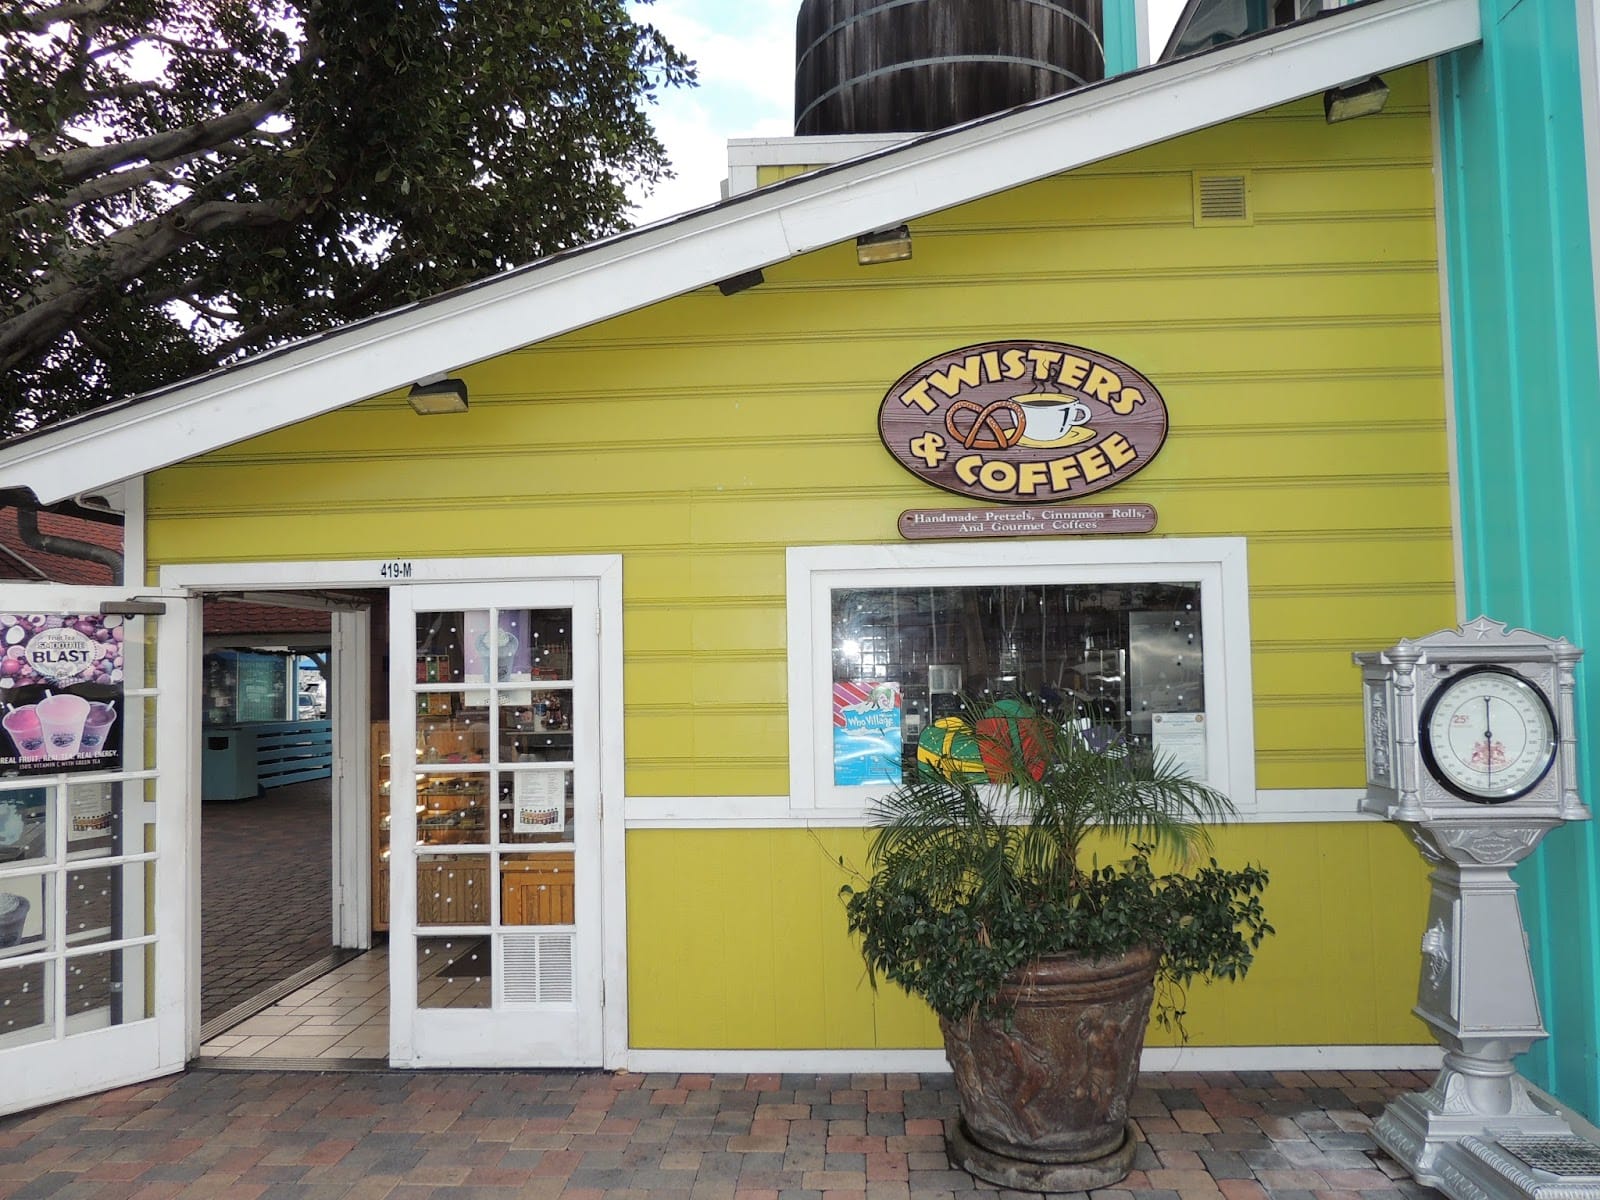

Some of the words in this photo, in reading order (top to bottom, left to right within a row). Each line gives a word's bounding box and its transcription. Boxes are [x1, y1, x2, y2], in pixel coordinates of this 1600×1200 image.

[900, 349, 1145, 415] TWISTERS
[910, 431, 949, 468] &
[954, 431, 1138, 494] COFFEE
[914, 512, 978, 523] Handmade
[986, 511, 1035, 522] Pretzels,
[1041, 509, 1104, 521] Cinnamon
[1112, 508, 1146, 519] Rolls,
[958, 522, 984, 533] And
[991, 521, 1045, 532] Gourmet
[1052, 519, 1098, 530] Coffees
[381, 562, 412, 578] 419-M
[32, 650, 90, 663] BLAST
[0, 756, 16, 764] REAL
[76, 751, 92, 759] REAL
